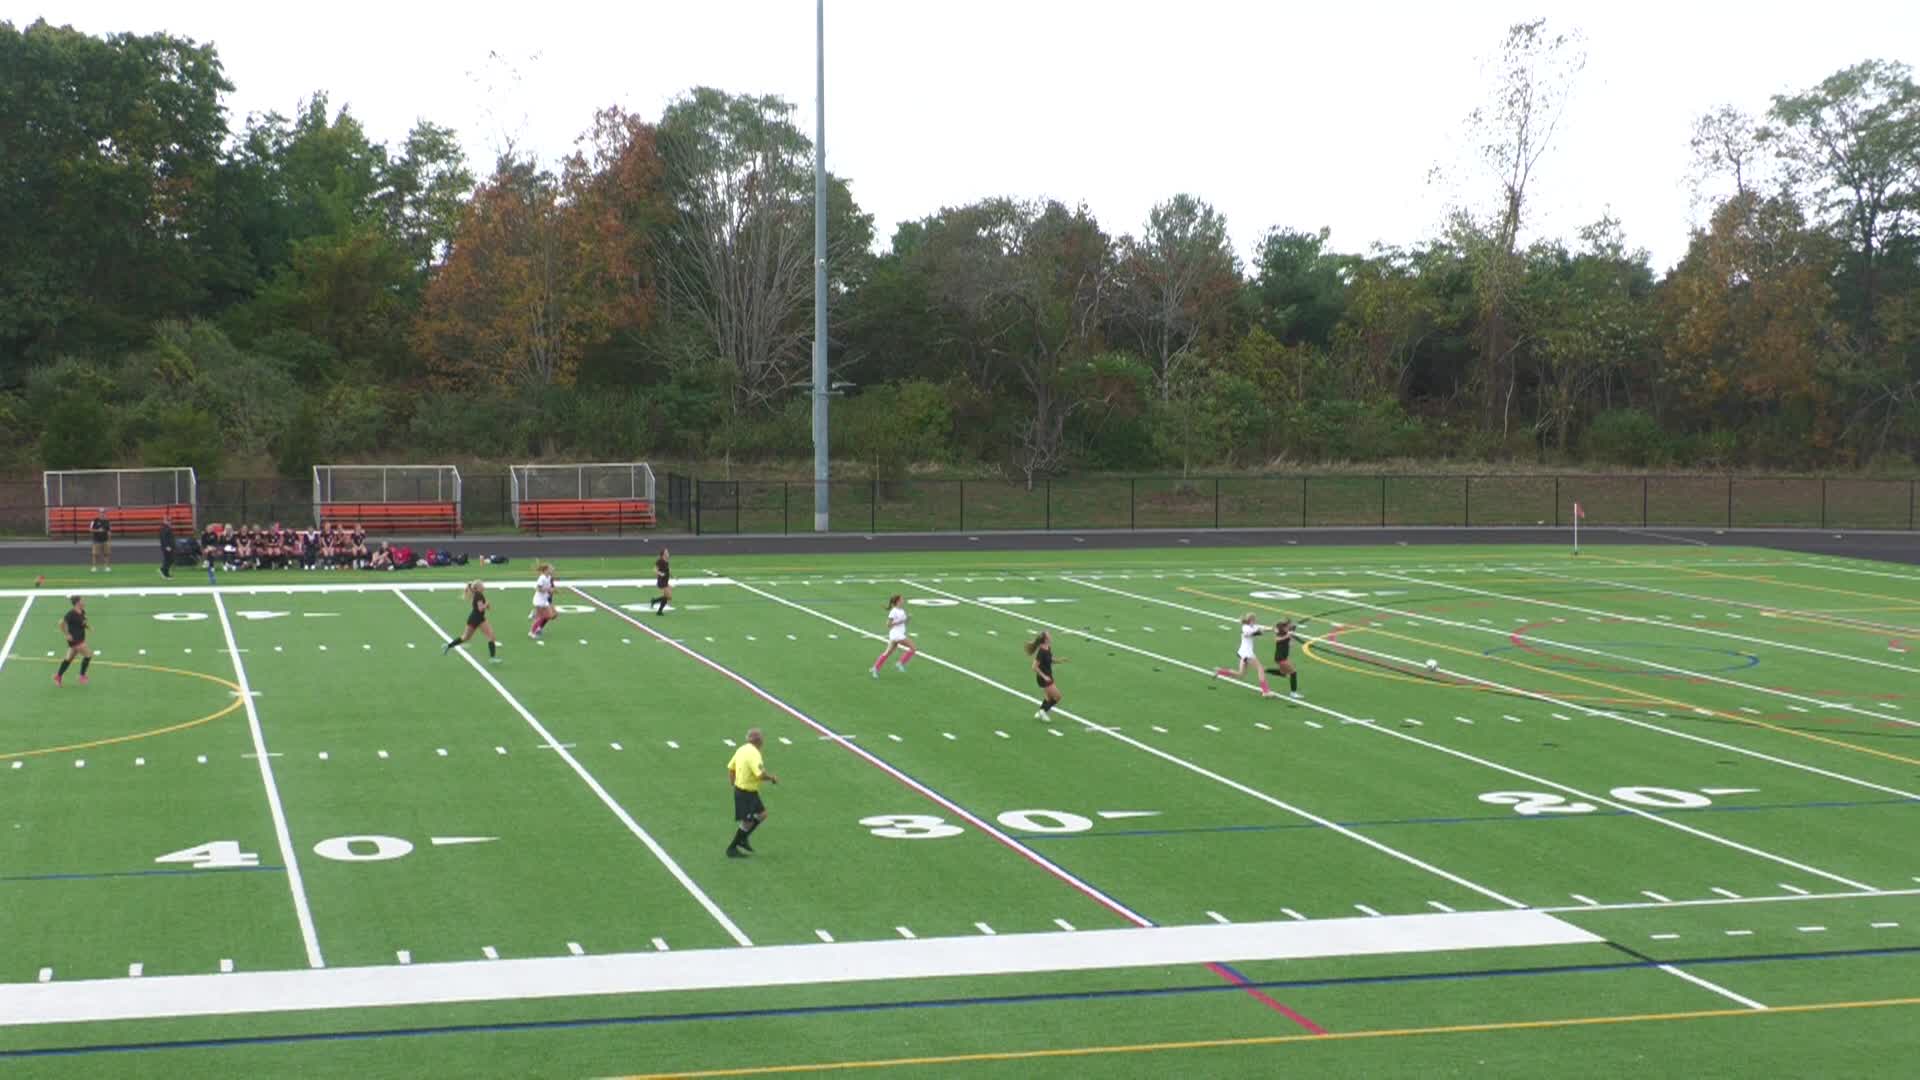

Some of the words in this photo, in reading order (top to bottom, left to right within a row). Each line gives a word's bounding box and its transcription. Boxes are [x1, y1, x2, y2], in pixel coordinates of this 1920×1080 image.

[1478, 786, 1713, 815] 20
[858, 809, 1094, 839] 30
[155, 835, 414, 868] 40
